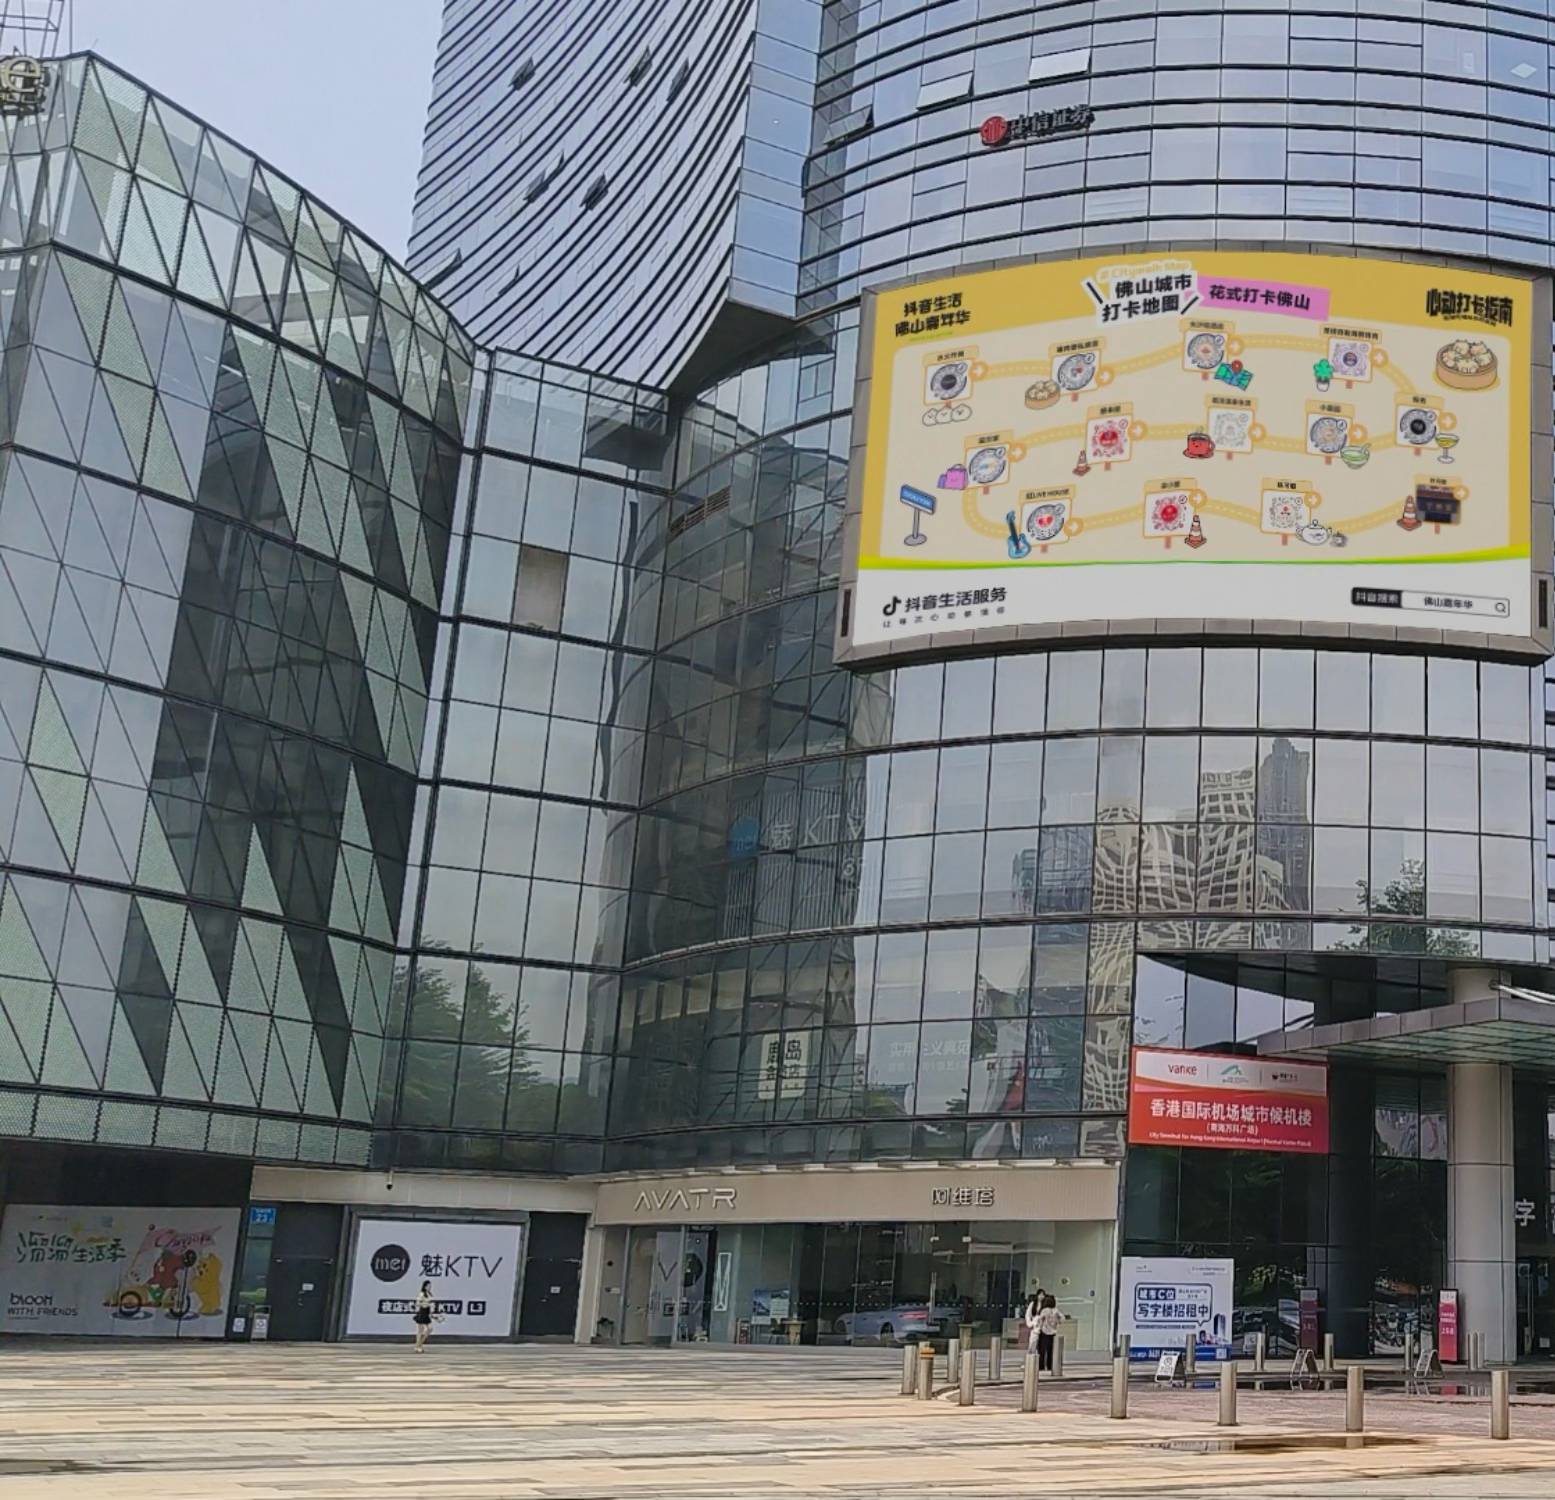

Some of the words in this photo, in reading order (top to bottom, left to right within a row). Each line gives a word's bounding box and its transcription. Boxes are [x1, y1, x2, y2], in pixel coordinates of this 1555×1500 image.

[1115, 274, 1192, 299] 佛山城市
[1209, 284, 1311, 310] 花式打卡佛山
[904, 292, 962, 317] 抖音生活
[1102, 294, 1179, 322] 打卡地图
[1426, 288, 1514, 327] 心动打卡指南
[895, 309, 971, 337] 佛山嘉年华
[904, 587, 1007, 613] 抖音生活服务
[1150, 1098, 1313, 1128] 香港国际机场城市候机楼
[634, 1188, 737, 1211] AVATR
[931, 1186, 995, 1207] 阿维塔
[418, 1252, 503, 1278] 魅KTV
[438, 1302, 461, 1313] KTV
[1138, 1303, 1209, 1318] 写字楼招租中
